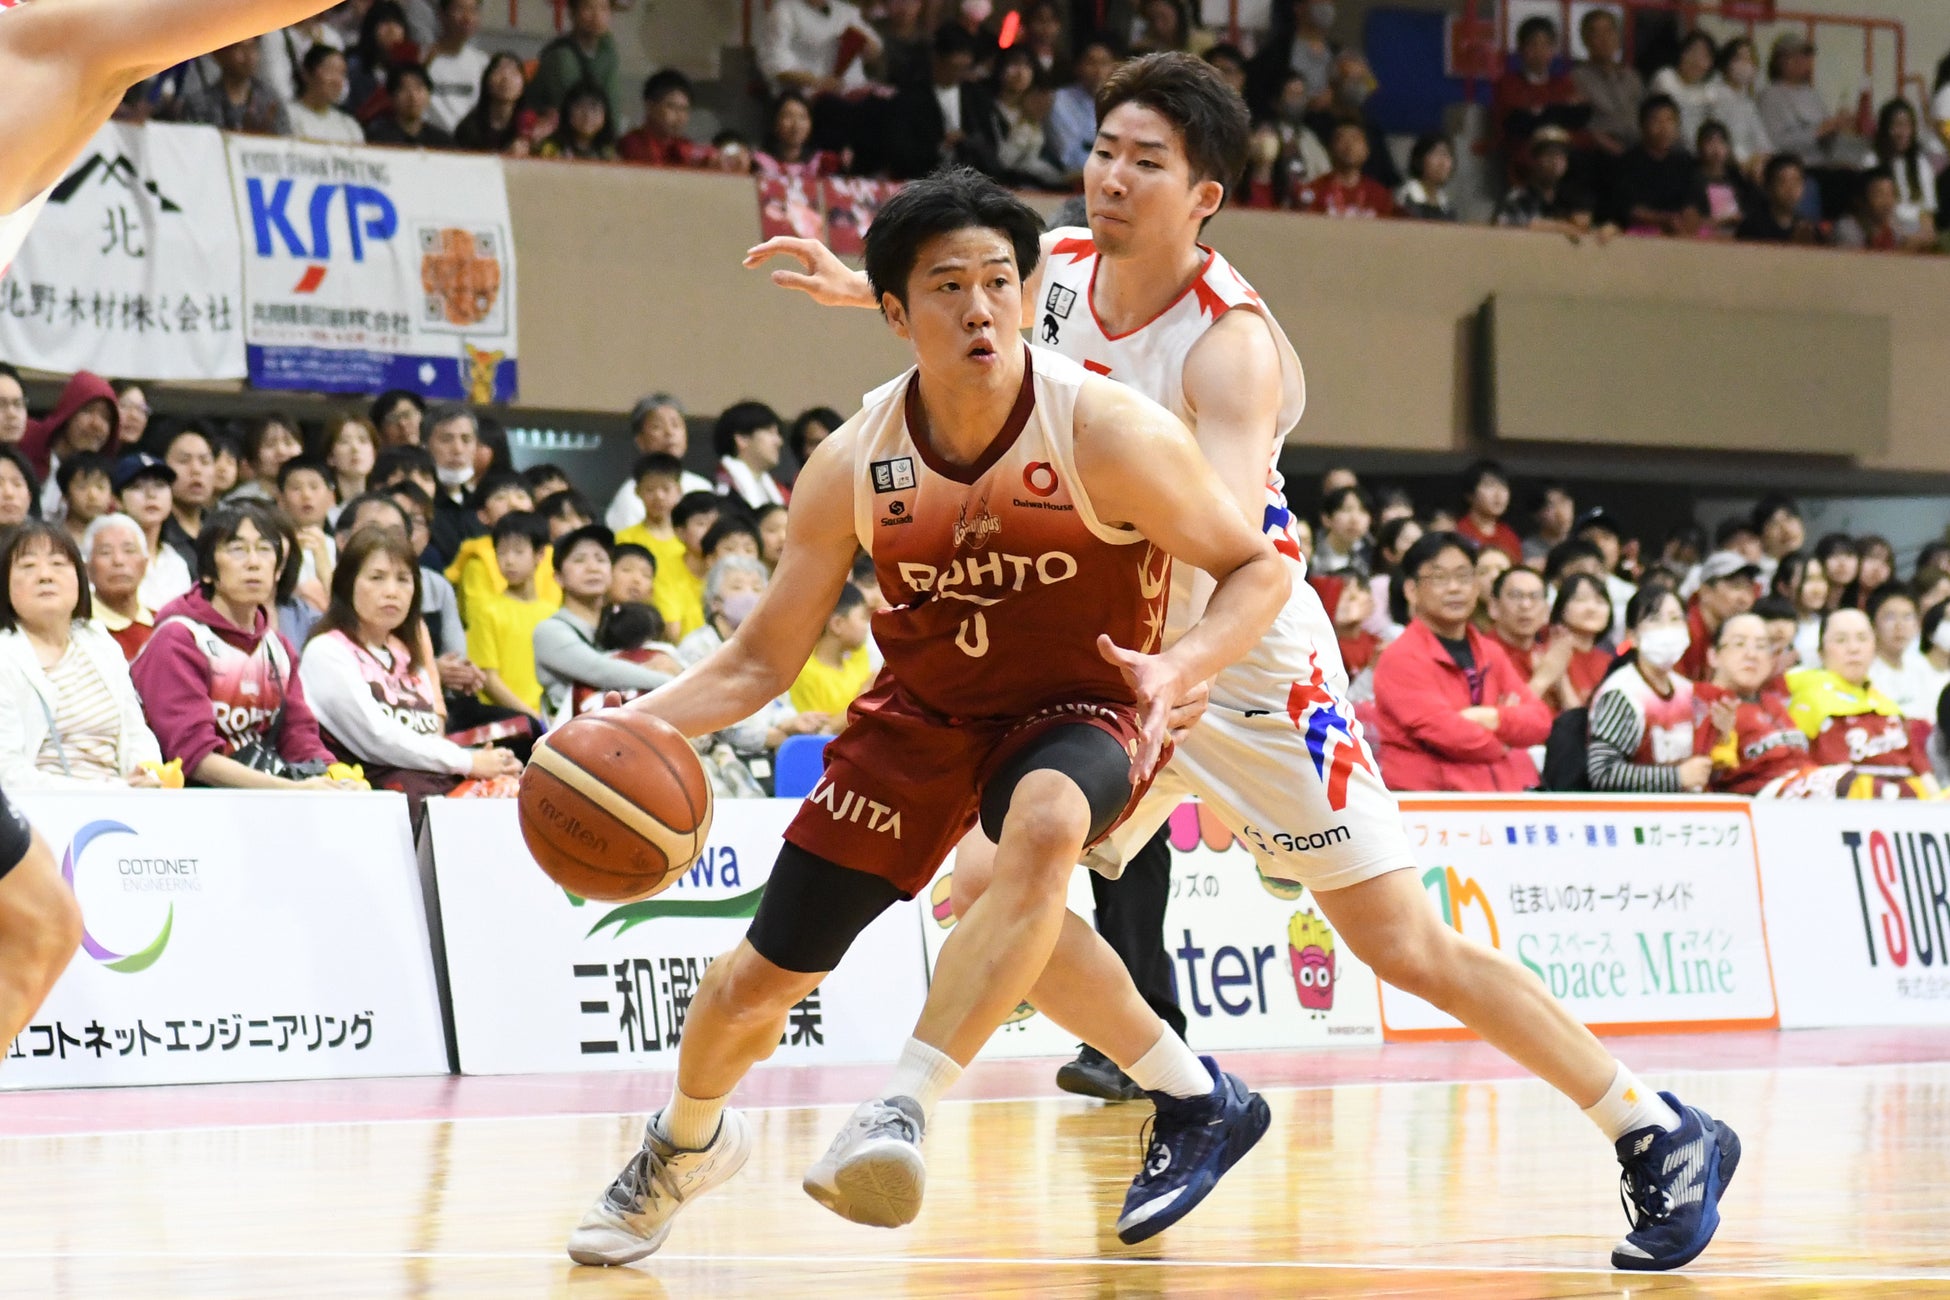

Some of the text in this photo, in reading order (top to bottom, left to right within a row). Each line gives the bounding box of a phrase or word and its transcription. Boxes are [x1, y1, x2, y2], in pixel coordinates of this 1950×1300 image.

[102, 206, 145, 258] 北
[246, 177, 398, 262] KSP
[1043, 501, 1074, 511] House
[538, 797, 609, 853] molten
[1403, 824, 1493, 846] フォーム
[118, 858, 199, 875] COTONET
[677, 845, 741, 888] wa
[1509, 883, 1694, 915] 住まいのオーダーメイド
[1635, 931, 1736, 995] Mine
